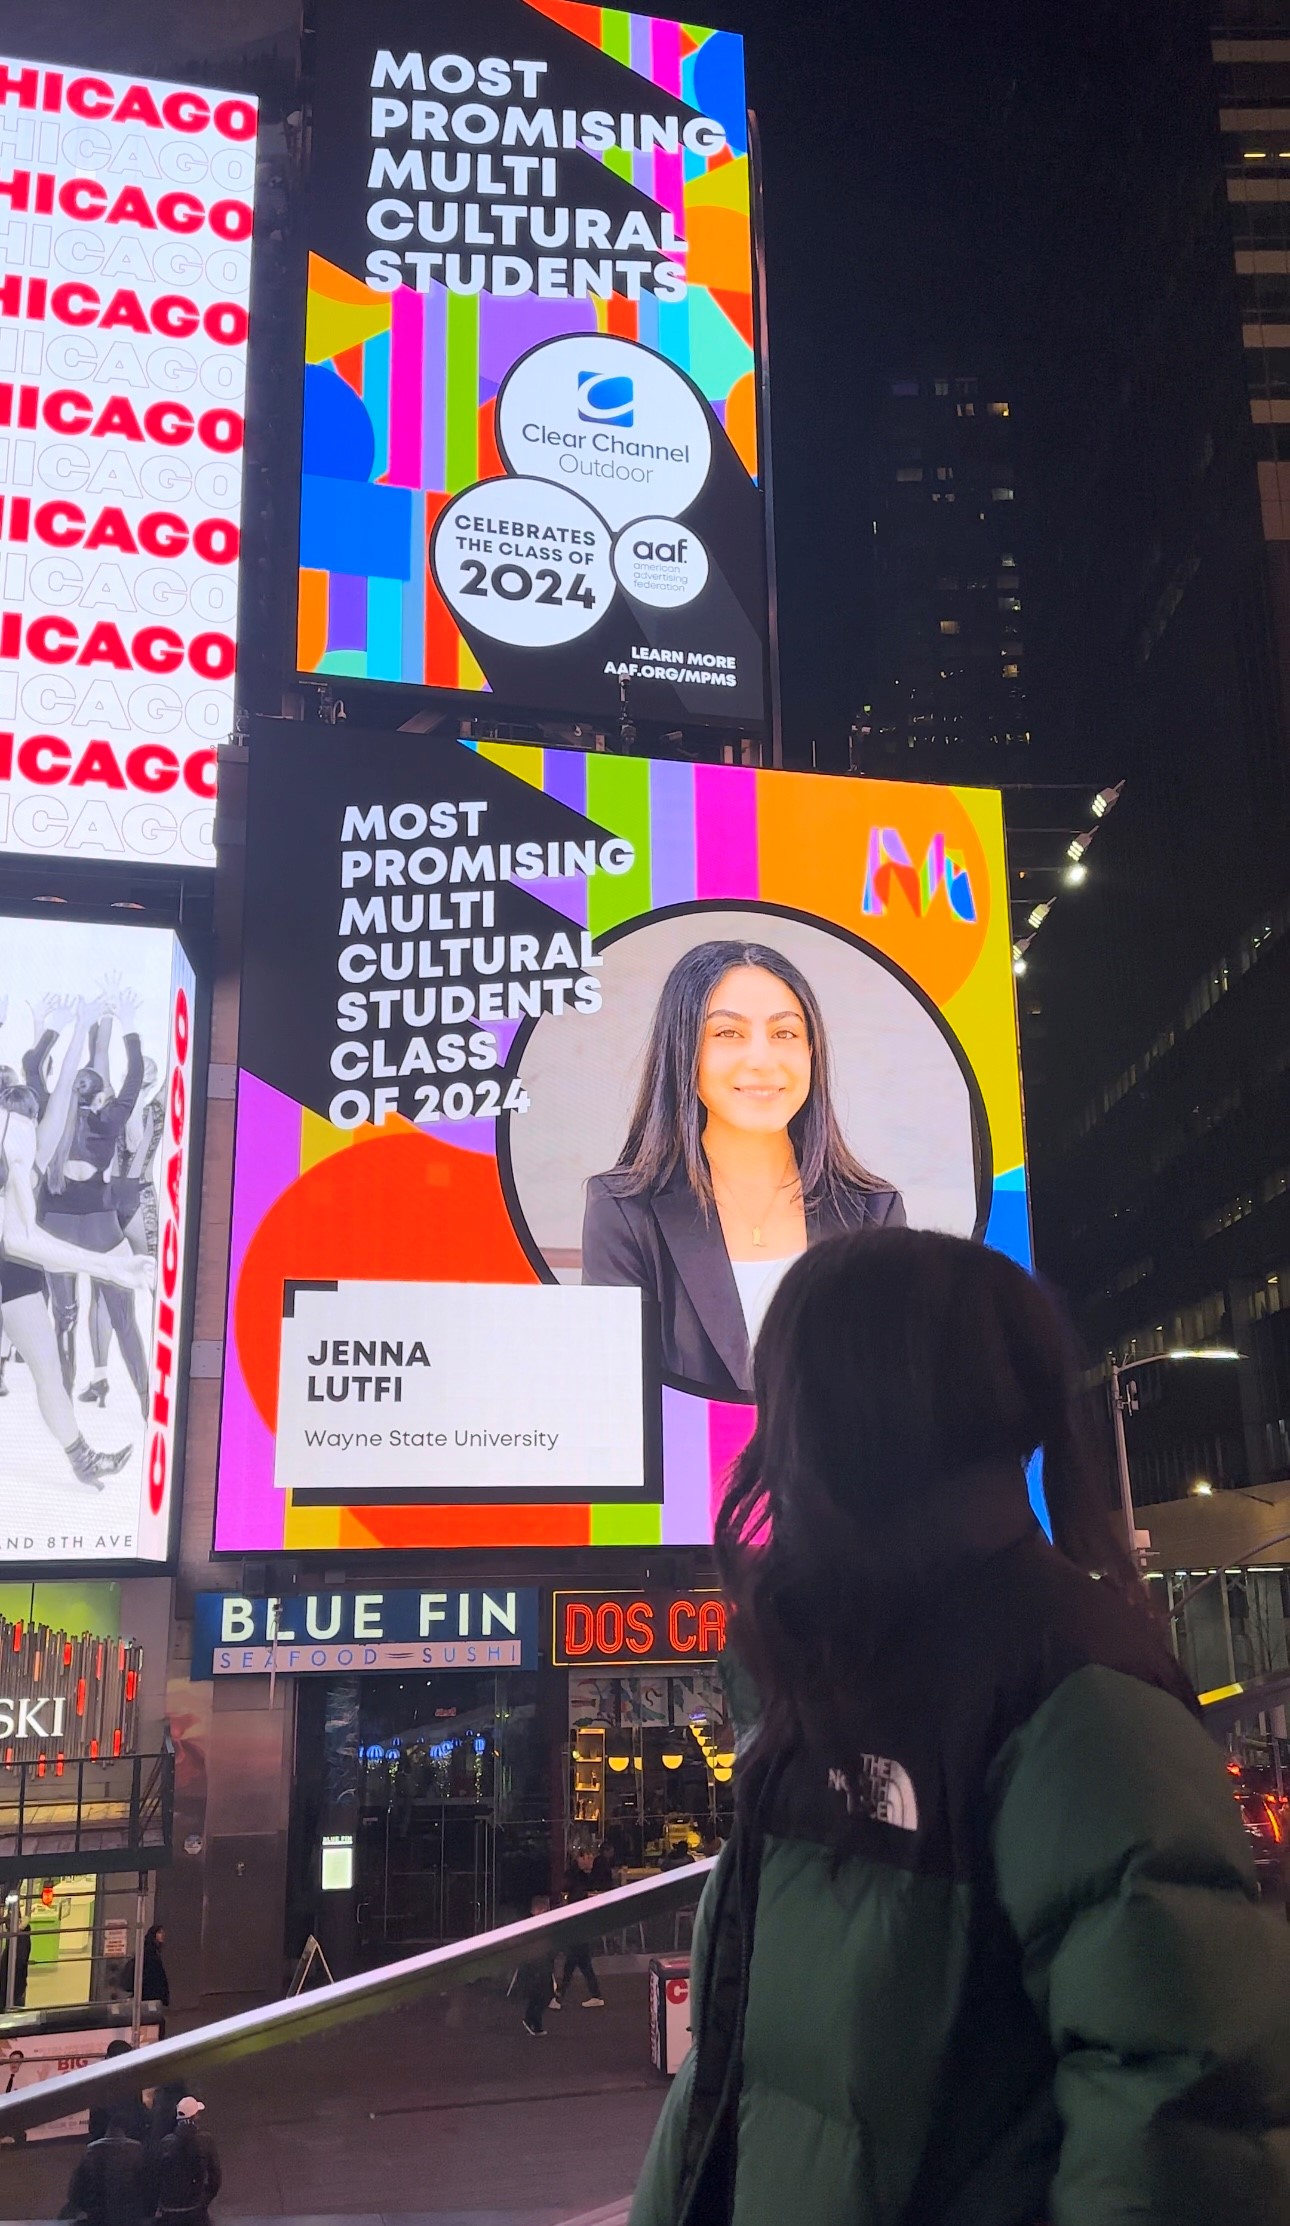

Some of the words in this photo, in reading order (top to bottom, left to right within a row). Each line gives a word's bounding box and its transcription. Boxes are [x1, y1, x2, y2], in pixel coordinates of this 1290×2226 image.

[370, 50, 548, 98] MOST
[370, 97, 726, 156] PROMISING
[367, 147, 557, 197] MULTI
[366, 198, 689, 253] CULTURAL
[365, 249, 688, 302] STUDENTS
[522, 423, 587, 448] Clear
[592, 433, 690, 463] Channel
[0, 438, 243, 510] ICAGO
[559, 453, 654, 484] Outdoor
[455, 515, 596, 546] CELEBRATES
[456, 536, 493, 553] THE
[499, 542, 563, 562] CLASS
[568, 551, 595, 565] OF
[459, 559, 596, 610] 2024
[633, 562, 681, 573] american
[633, 571, 688, 585] advertising
[633, 579, 685, 592] federation
[603, 661, 737, 687] AAF.ORG/MPMS
[631, 646, 684, 664] LEARN
[687, 652, 737, 669] MORE
[340, 801, 488, 842] MOST
[341, 838, 635, 888] PROMISING
[338, 890, 495, 936] MULTI
[337, 931, 603, 984] CULTURAL
[336, 977, 603, 1032] STUDENTS
[330, 1032, 498, 1082] CLASS
[328, 1086, 400, 1130] OF
[413, 1078, 531, 1124] 2024
[149, 986, 190, 1516] CHICAGO
[307, 1340, 431, 1367] JENNA
[307, 1375, 402, 1402] LUTFI
[304, 1429, 383, 1450] Wayne
[389, 1429, 448, 1447] State
[455, 1429, 559, 1450] University
[0, 1537, 34, 1549] ND
[47, 1536, 83, 1549] 8TH
[95, 1535, 132, 1548] AVE
[221, 1594, 384, 1642] BLUE
[419, 1592, 516, 1637] FIN
[565, 1602, 654, 1655] DOS
[220, 1648, 377, 1669] SEAFOOD
[422, 1645, 515, 1664] SUSHI
